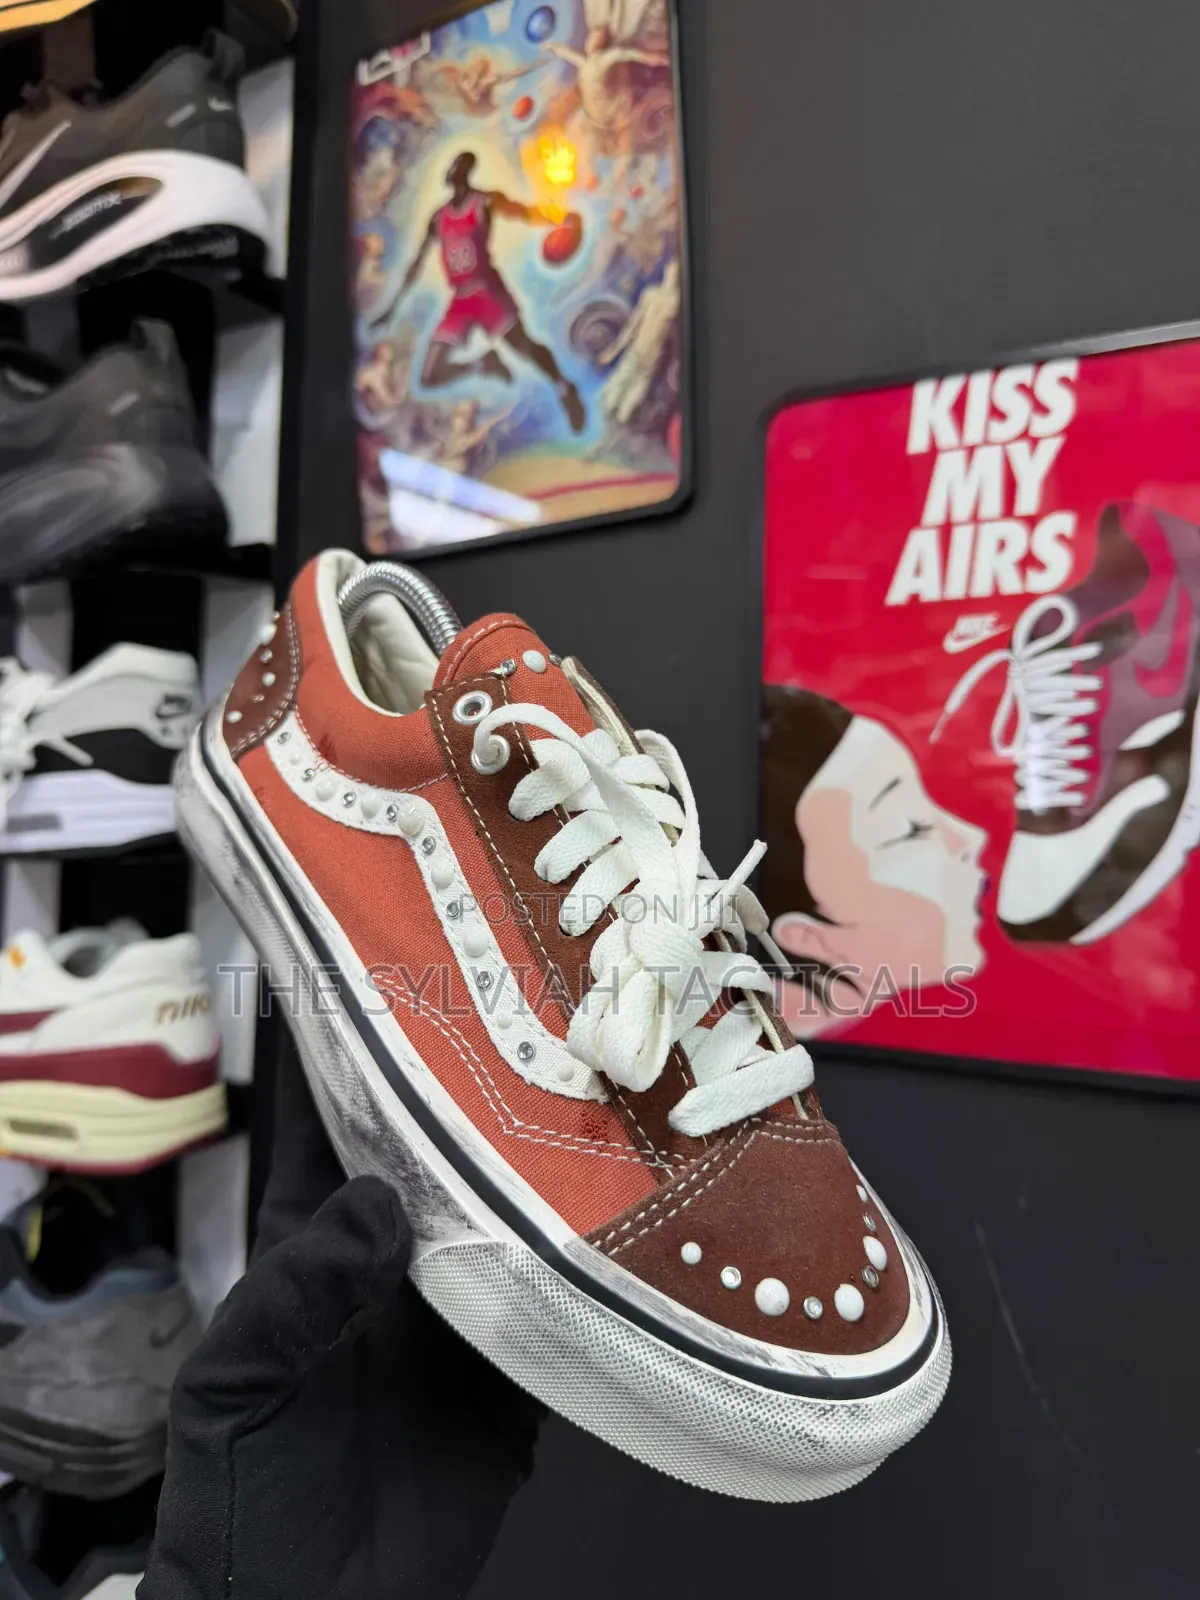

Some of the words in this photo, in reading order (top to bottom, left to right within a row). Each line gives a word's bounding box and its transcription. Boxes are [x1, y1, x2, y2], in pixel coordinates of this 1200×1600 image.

[906, 358, 1078, 455] KISS
[921, 436, 1067, 527] MY
[884, 511, 1077, 607] AIRS
